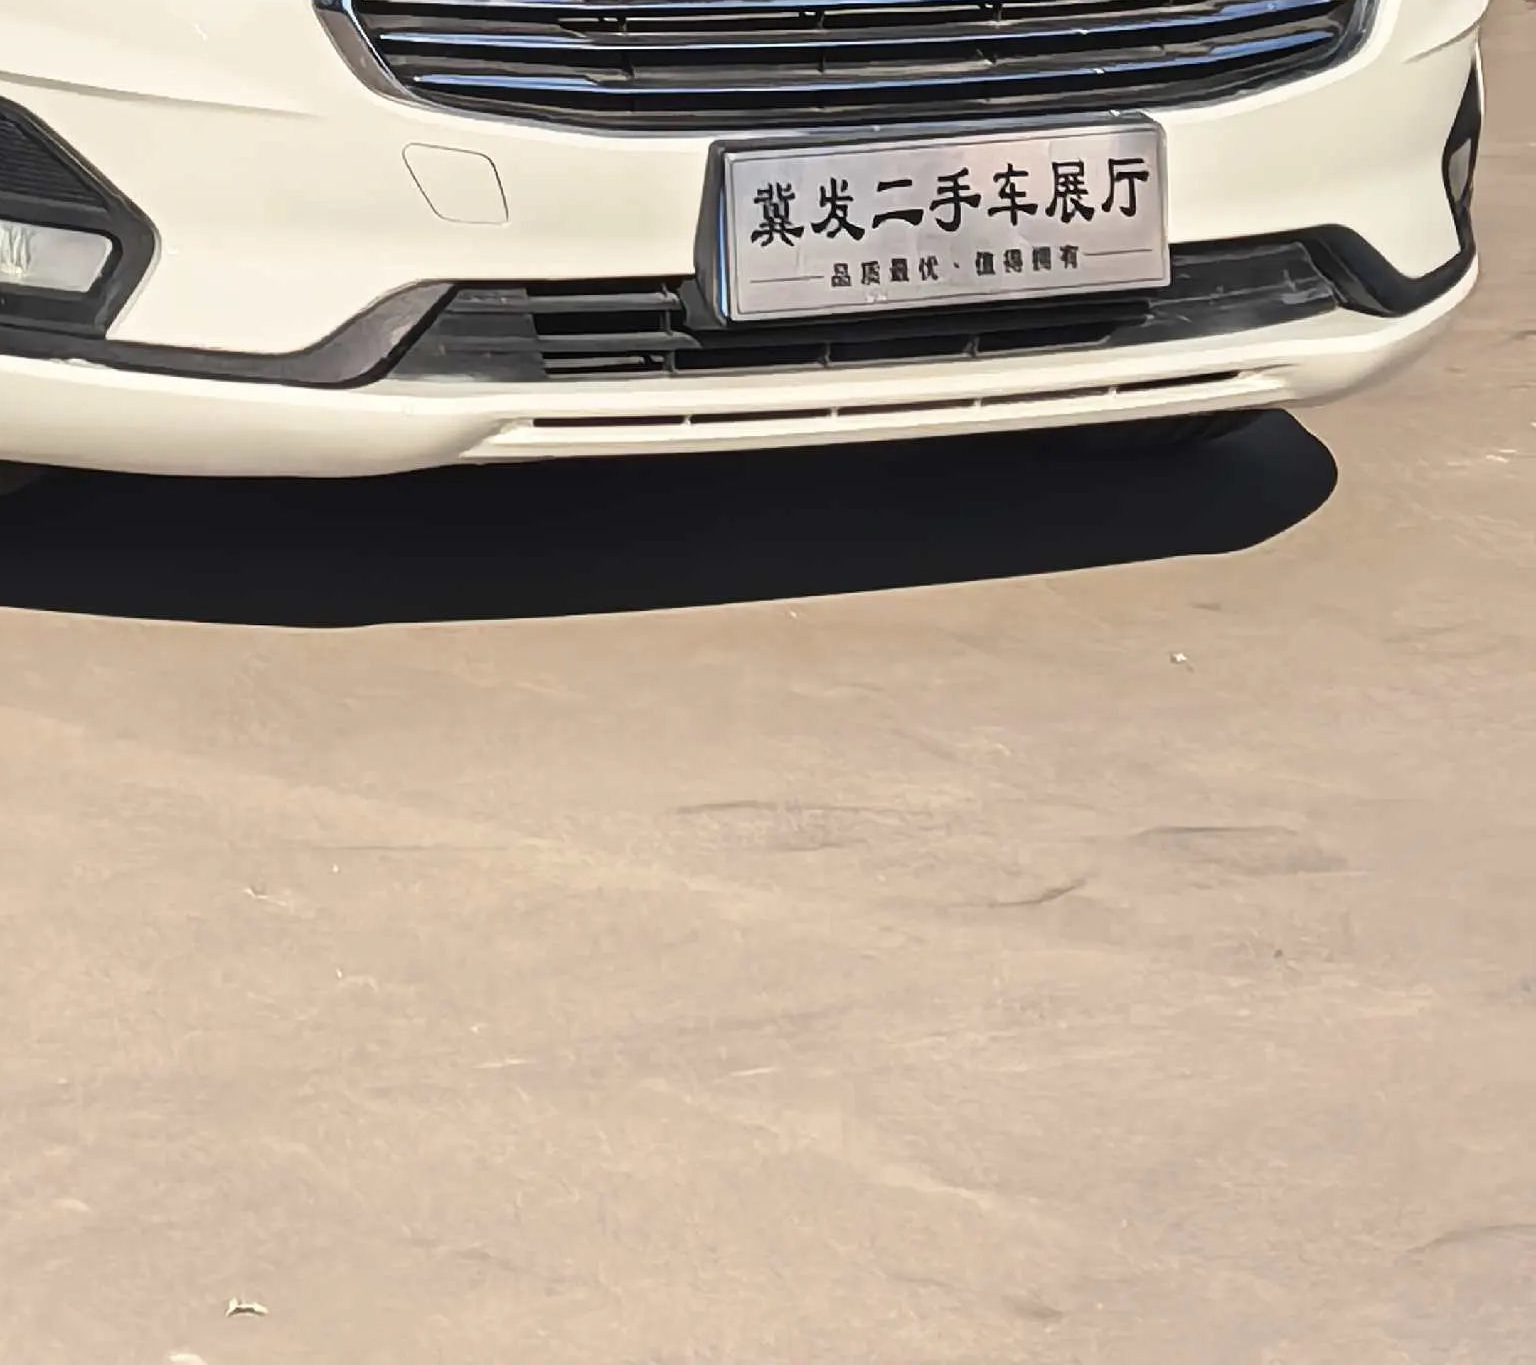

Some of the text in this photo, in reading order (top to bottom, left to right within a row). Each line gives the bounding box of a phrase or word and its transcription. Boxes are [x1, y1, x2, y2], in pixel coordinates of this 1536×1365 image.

[751, 158, 1150, 247] 冀发二手车展厅
